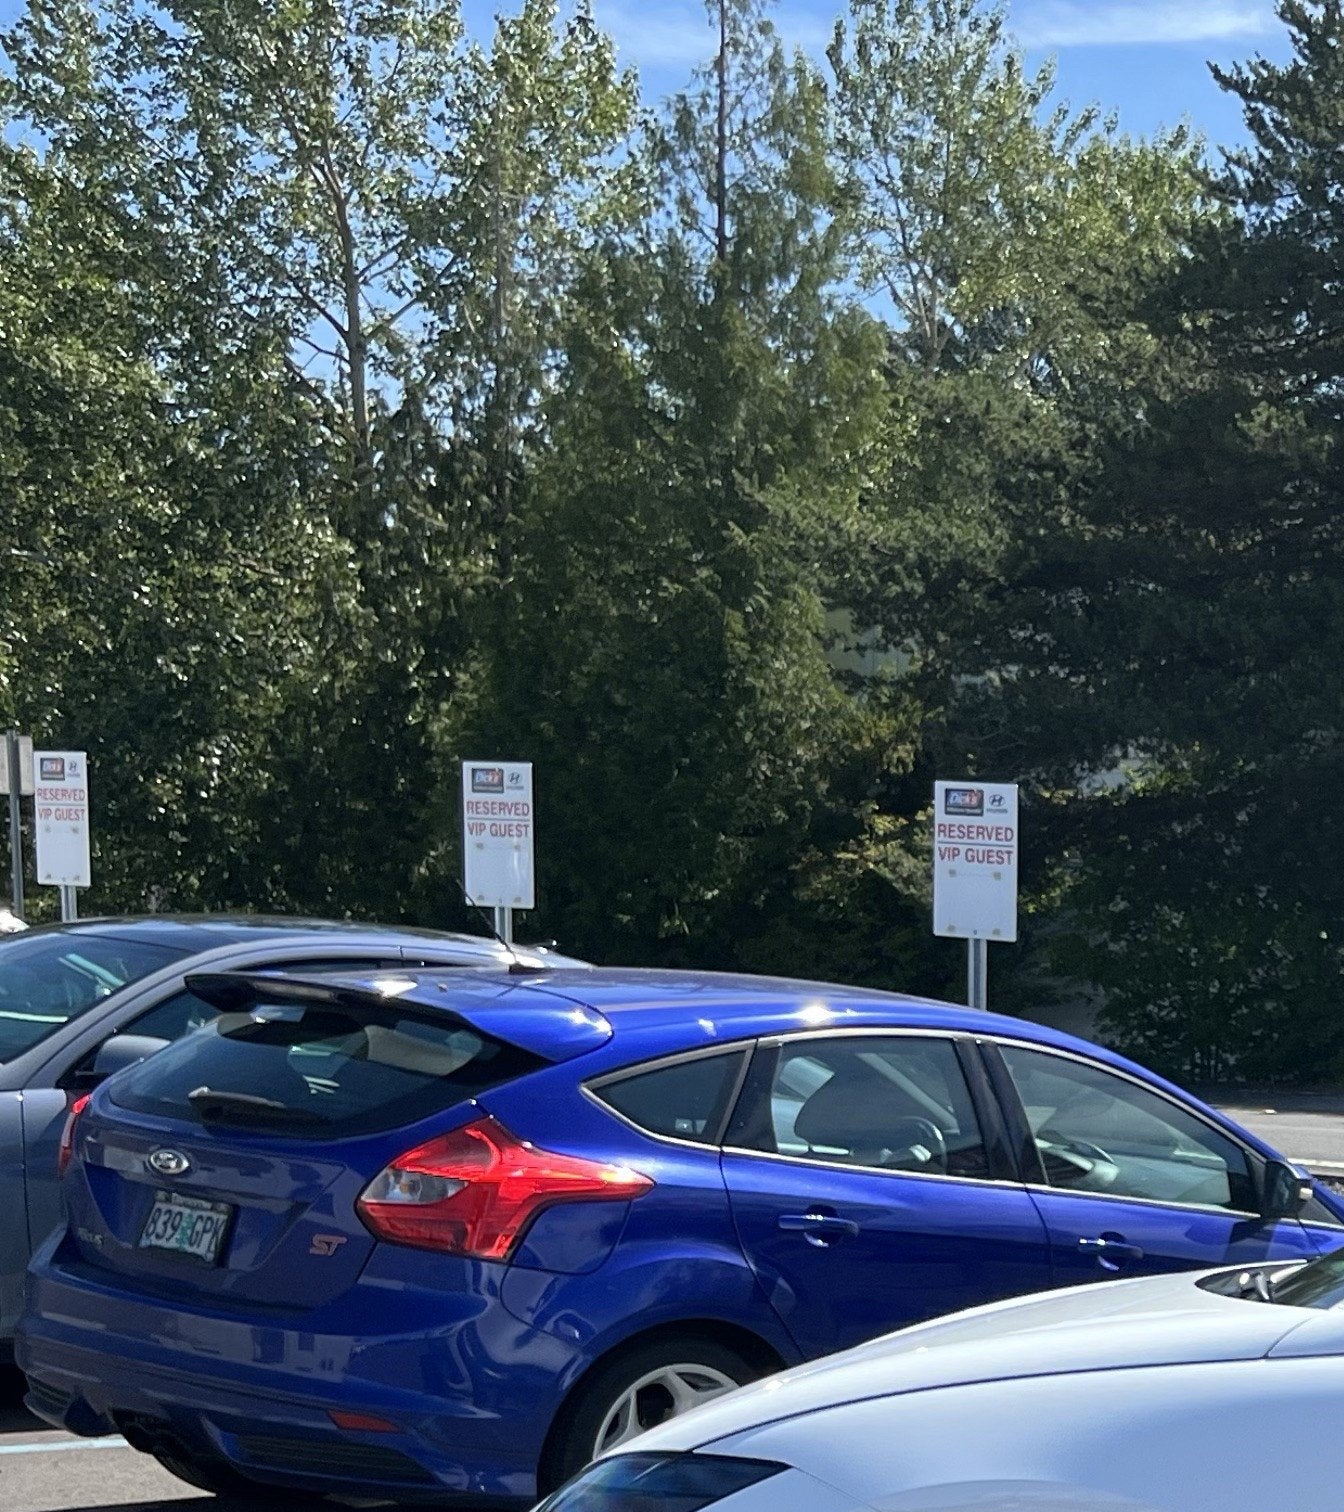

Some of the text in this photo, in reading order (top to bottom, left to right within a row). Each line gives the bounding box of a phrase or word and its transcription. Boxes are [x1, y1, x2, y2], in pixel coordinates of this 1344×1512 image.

[36, 788, 86, 801] RESERVED
[37, 808, 86, 822] VIP GUEST
[466, 800, 530, 817] RESERVED
[467, 822, 530, 838] VIP GUEST
[937, 823, 1014, 843] RESERVED
[937, 846, 1014, 866] VIP GUEST
[309, 1233, 348, 1257] ST
